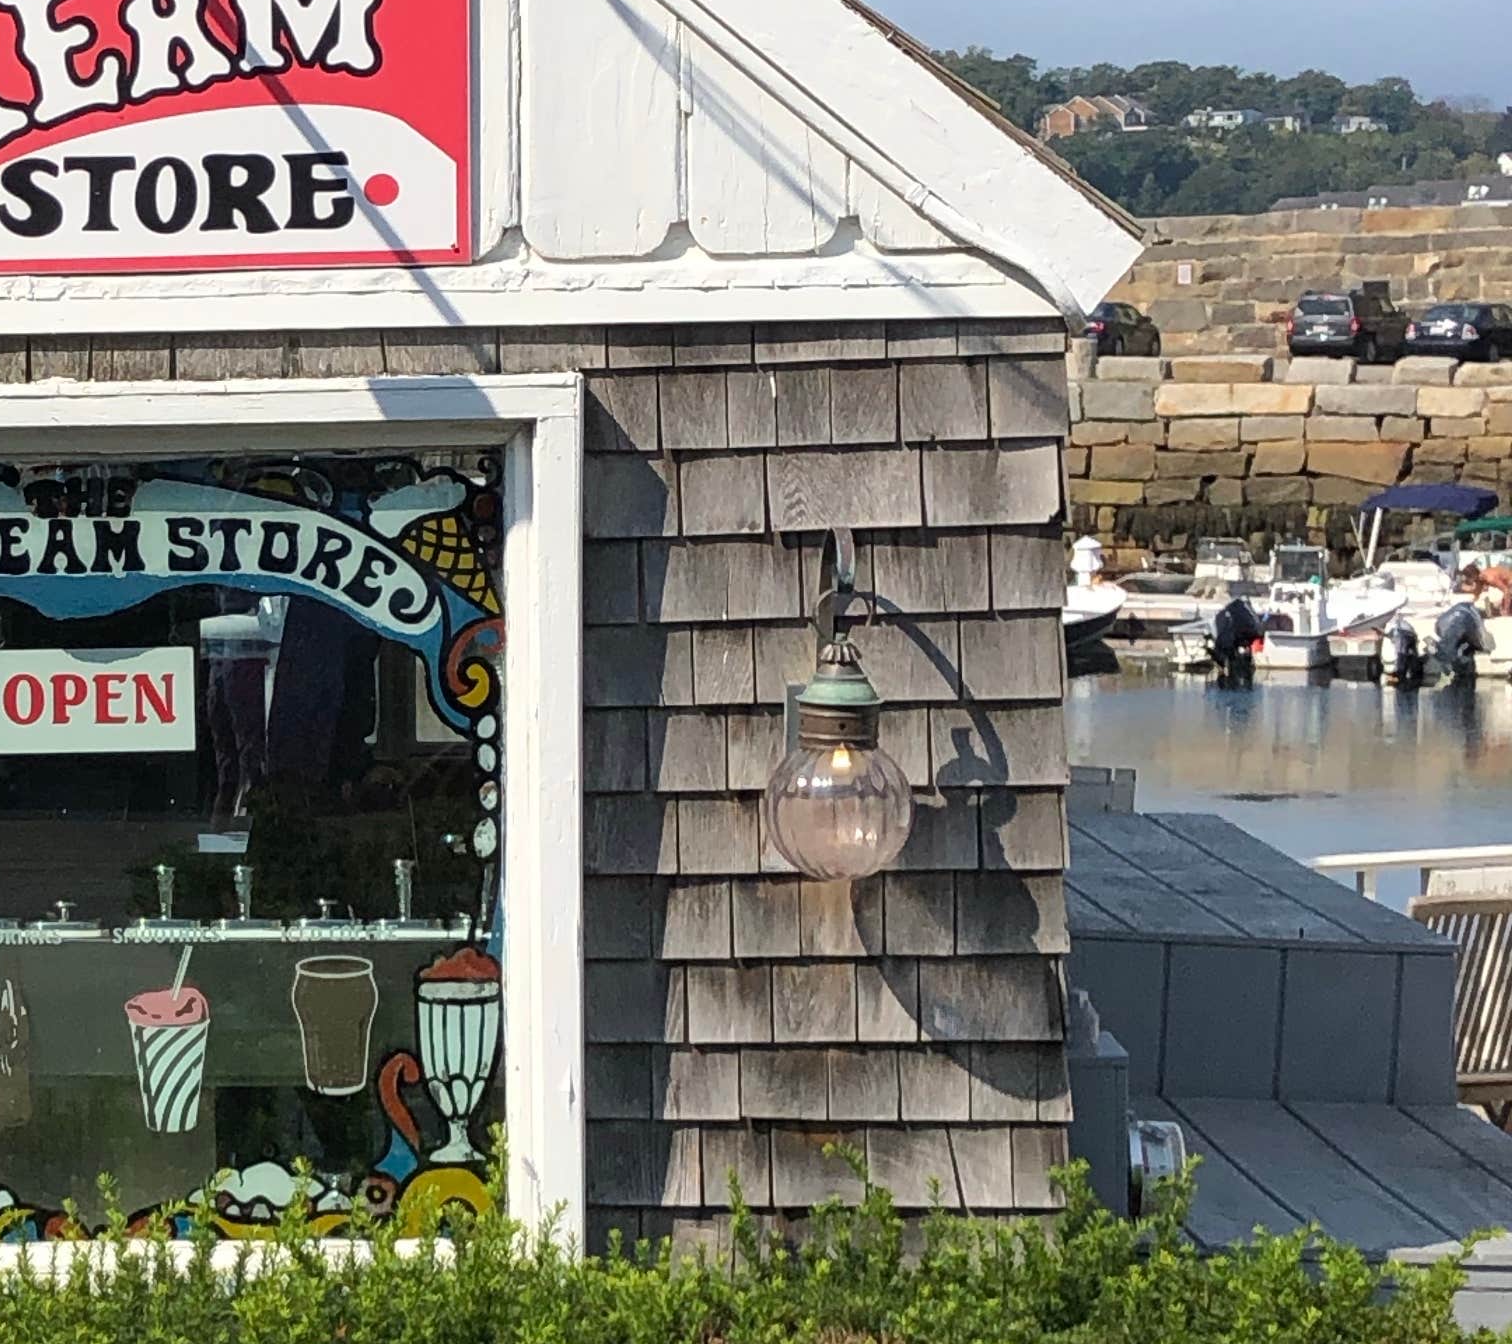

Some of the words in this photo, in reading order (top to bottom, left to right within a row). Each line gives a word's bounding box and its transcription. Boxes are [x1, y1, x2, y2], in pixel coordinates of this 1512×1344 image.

[24, 476, 137, 519] THE
[166, 516, 398, 612] STORE
[1, 673, 177, 725] OPEN
[111, 926, 222, 944] SMOOTHIES
[281, 925, 321, 943] ICED
